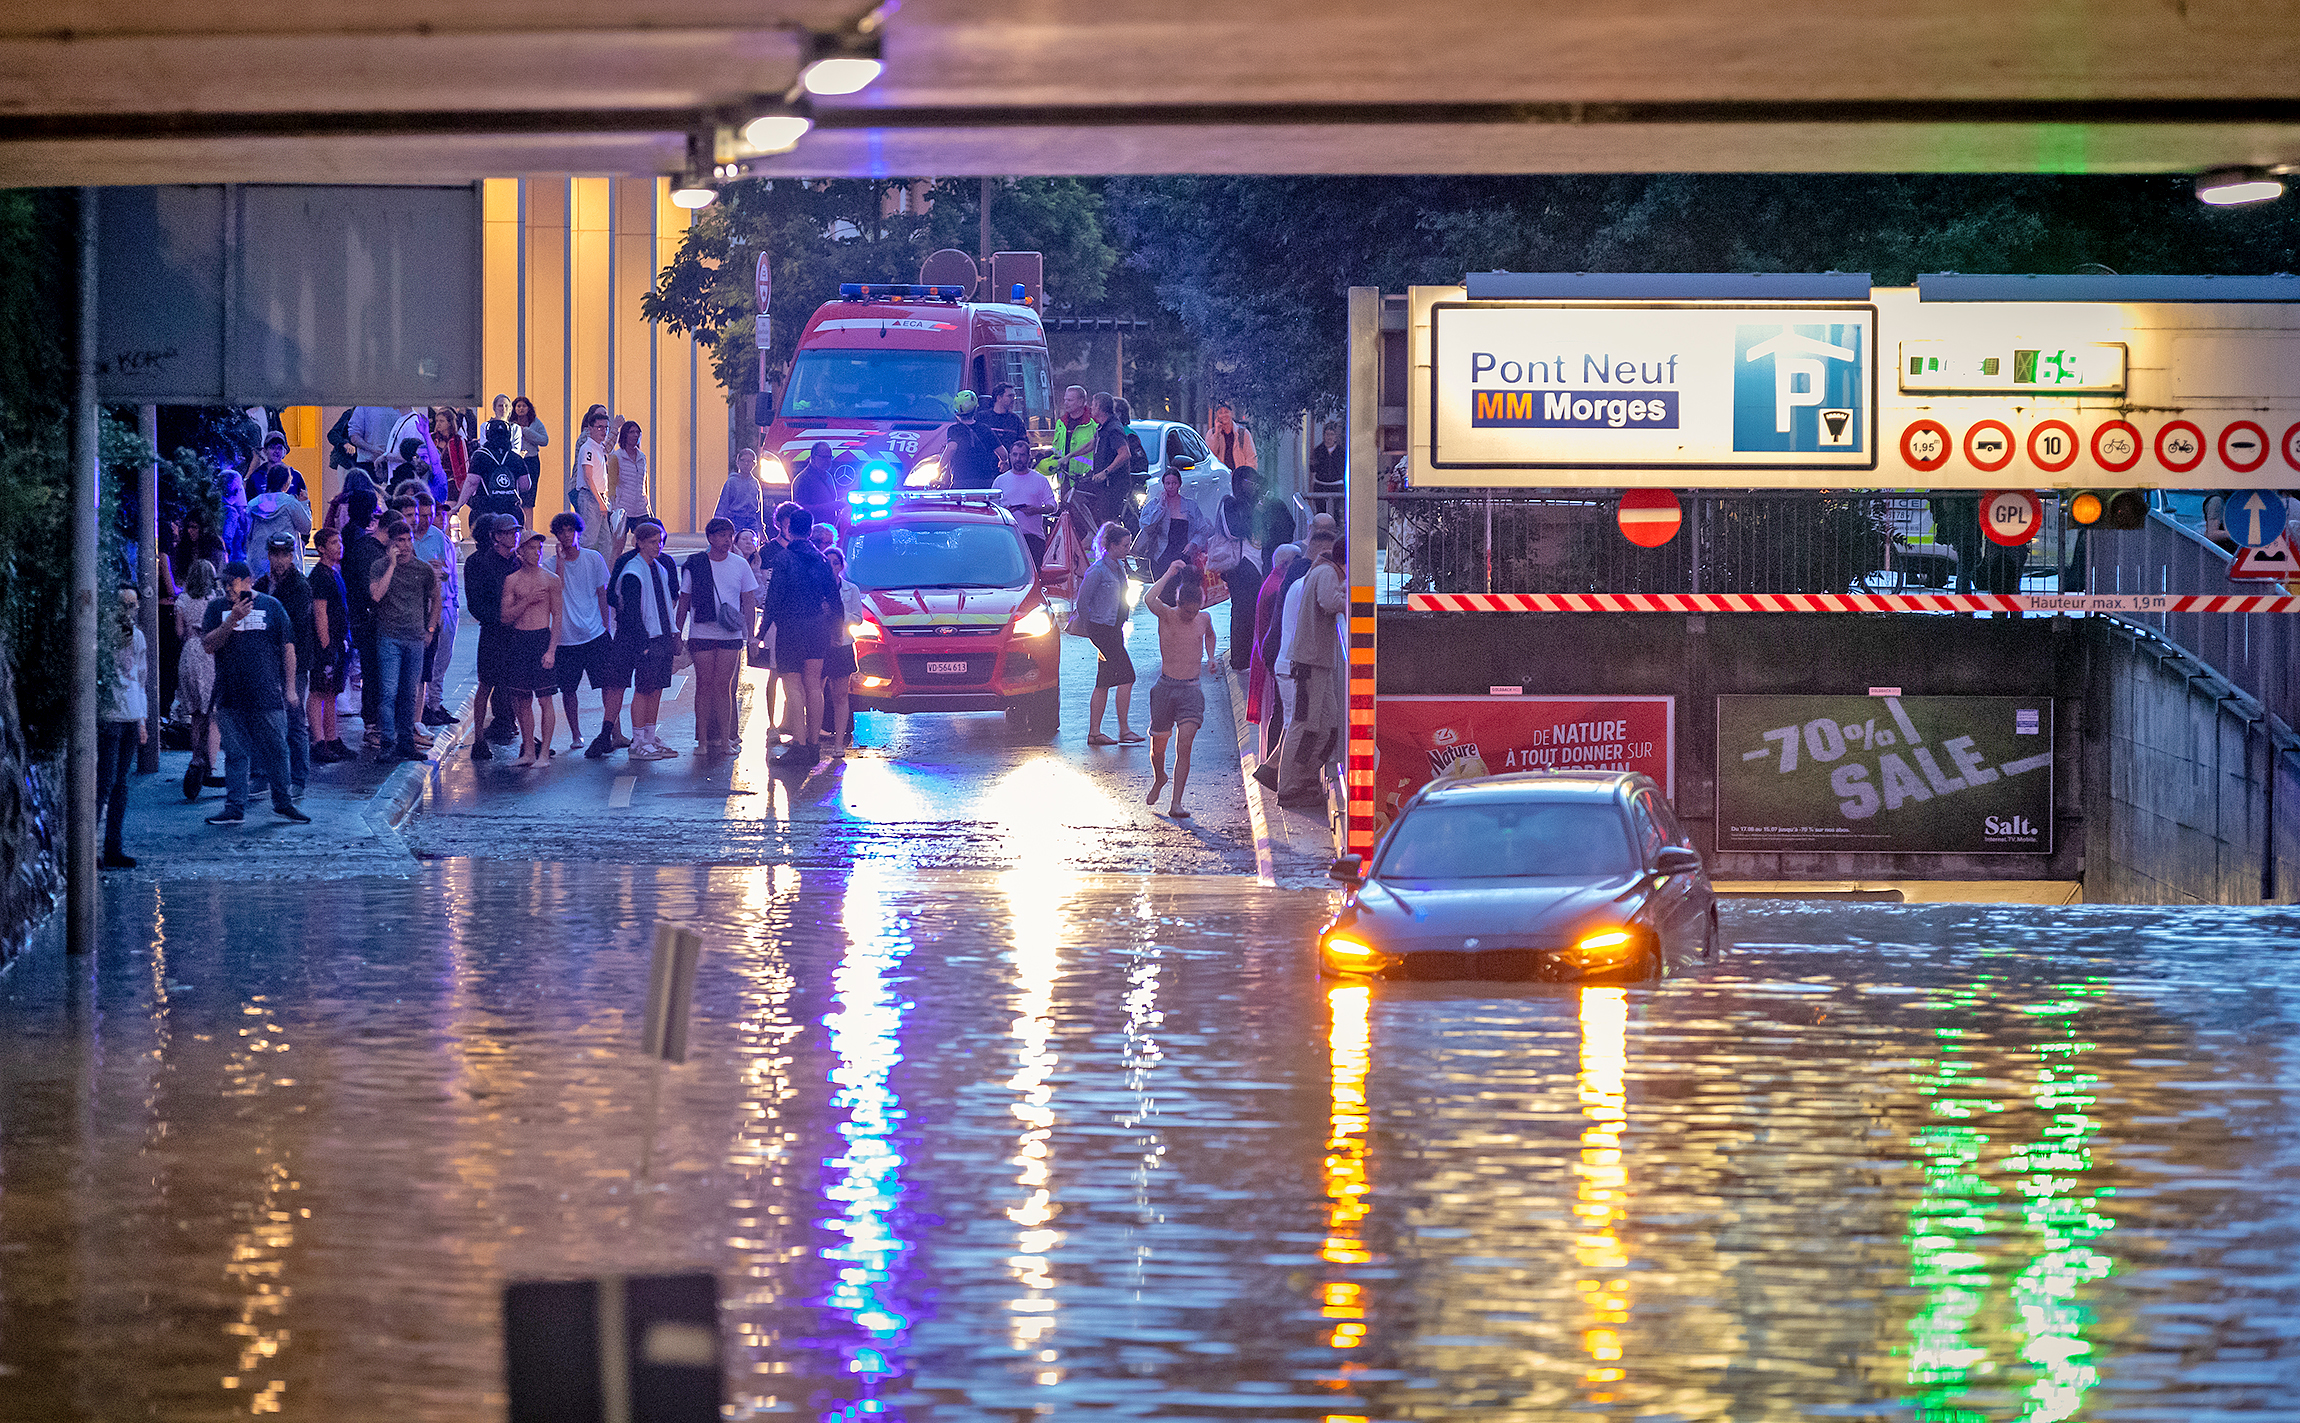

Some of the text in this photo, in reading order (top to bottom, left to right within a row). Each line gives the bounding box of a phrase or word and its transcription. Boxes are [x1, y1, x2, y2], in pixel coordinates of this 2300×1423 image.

[902, 320, 923, 328] ECA
[1472, 353, 1679, 384] Pont Neuf
[1477, 392, 1667, 427] MM Morges
[586, 451, 592, 461] 3
[886, 440, 919, 453] 118
[2044, 436, 2061, 455] 10
[1995, 505, 2028, 524] GPL
[2031, 597, 2086, 609] Hauteur
[2092, 599, 2126, 609] max.
[1533, 720, 1627, 746] DE NATURE
[1505, 748, 1516, 767] À
[1520, 748, 1558, 766] TOUT
[1562, 744, 1623, 763] DONNER
[1627, 742, 1653, 759] SUR
[1742, 718, 1897, 774] -70%
[1426, 744, 1476, 776] Nature
[1830, 735, 2000, 820] SALE
[1985, 815, 2038, 835] Salt.
